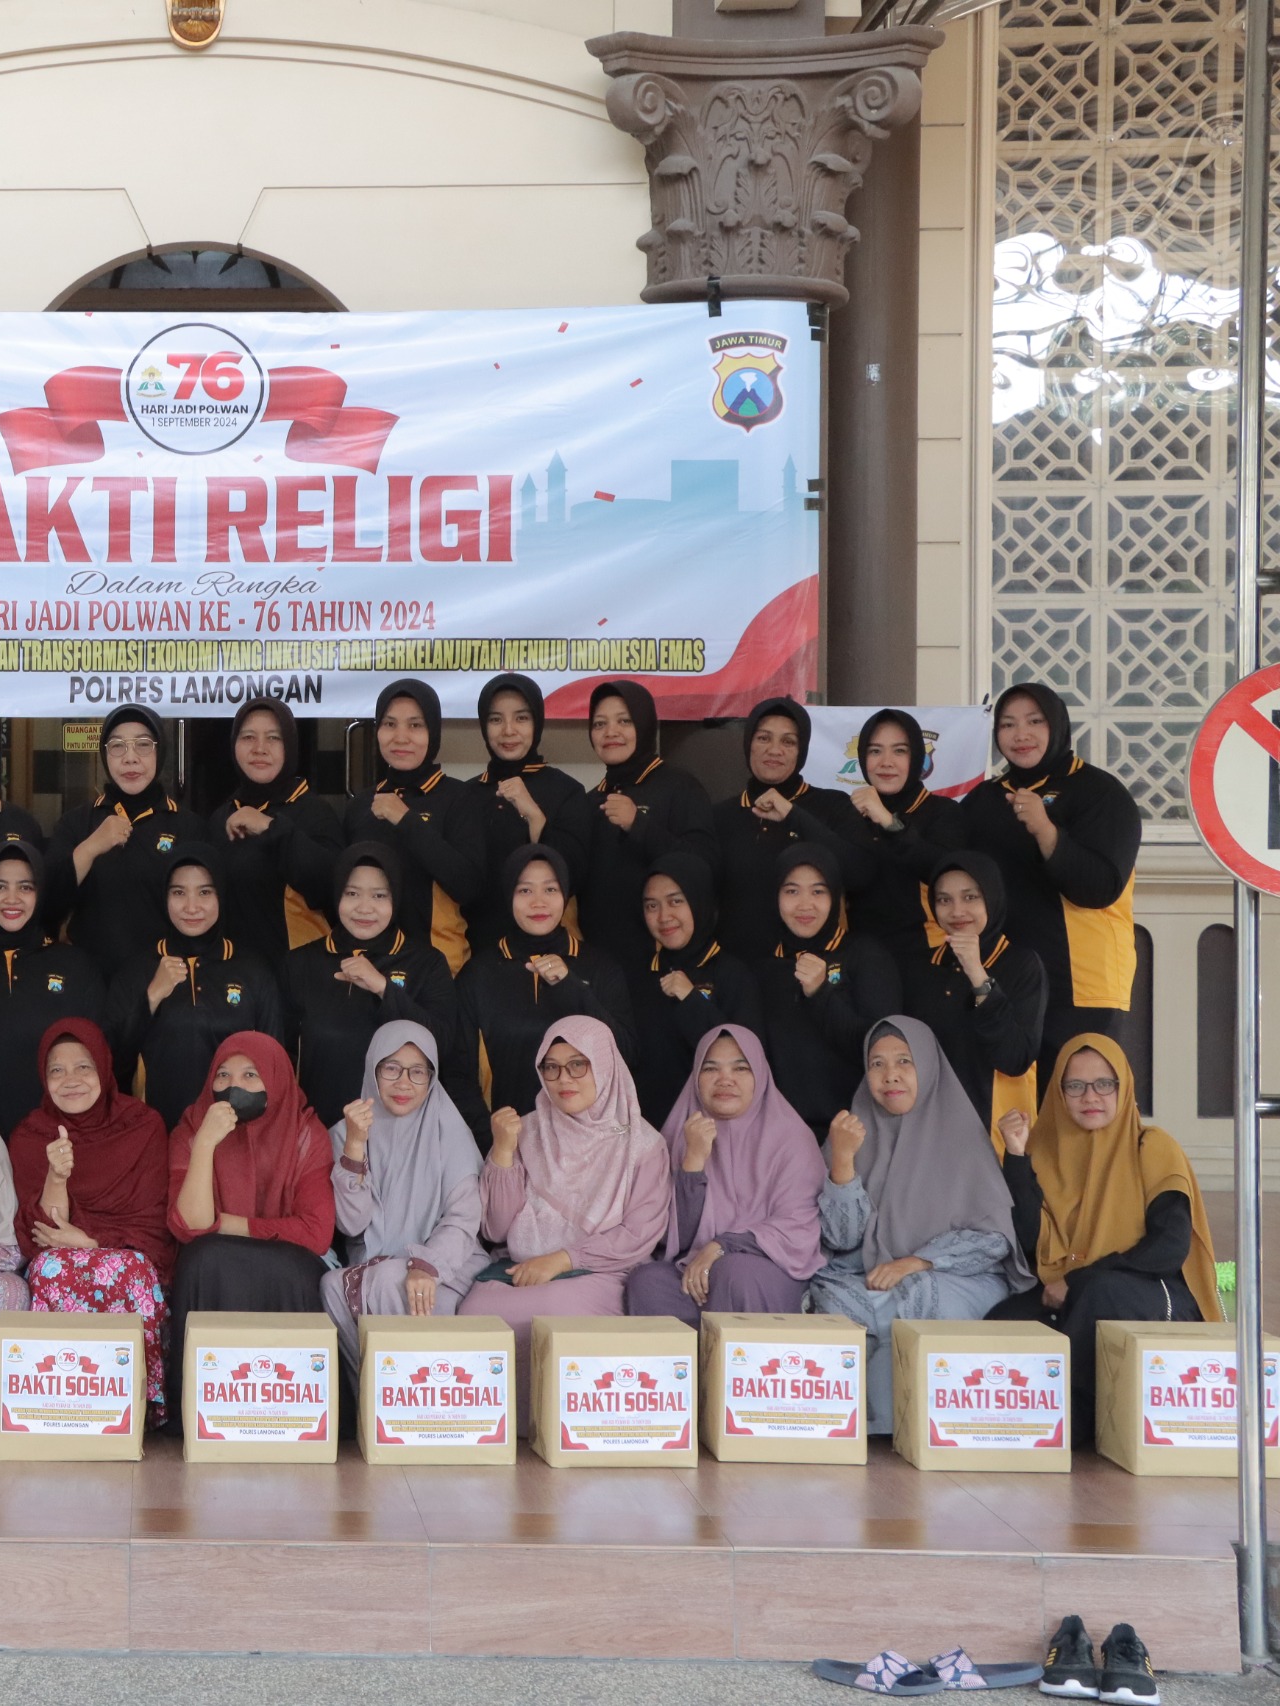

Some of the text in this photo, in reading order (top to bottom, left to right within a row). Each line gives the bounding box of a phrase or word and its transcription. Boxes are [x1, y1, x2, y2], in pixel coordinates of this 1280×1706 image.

[715, 335, 782, 349] JAWA TIMUR
[167, 351, 245, 402] 76
[141, 404, 249, 414] HARI JADI POLWAN
[157, 417, 210, 427] SEPTEMBER
[213, 417, 238, 427] 2024
[205, 475, 514, 563] RELIGI
[66, 570, 322, 600] Dalam Rangka
[25, 600, 80, 632] JADI
[88, 600, 191, 632] POLWAN
[199, 600, 231, 632] KE
[253, 600, 281, 632] 76
[288, 600, 372, 632] TAHUN
[380, 600, 436, 632] 2024
[21, 638, 144, 671] TRANSFORMASI
[146, 638, 220, 671] EKONOMI
[221, 638, 263, 671] YANG
[264, 638, 339, 671] INKLUSIF
[339, 638, 374, 671] DAN
[375, 638, 502, 671] BERKELANJUTAN
[504, 638, 568, 671] MENUJU
[570, 638, 657, 671] INDONESIA
[659, 638, 705, 671] EMAS
[70, 674, 323, 704] POLRES LAMONGAN
[63, 1353, 75, 1362] 76
[258, 1360, 270, 1369] 76
[788, 1356, 800, 1365] 76
[437, 1364, 449, 1372] 76
[621, 1369, 633, 1378] 76
[1207, 1364, 1220, 1373] 76
[8, 1374, 128, 1396] BAKTI SOSIAL
[204, 1382, 324, 1403] BAKTI SOSIAL
[733, 1378, 853, 1400] BAKTI SOSIAL
[382, 1387, 502, 1406] BAKTI SOSIAL
[567, 1392, 687, 1412] BAKTI SOSIAL
[935, 1389, 1059, 1409] BAKTI SOSIAL
[1150, 1386, 1275, 1408] BAKTI SOL
